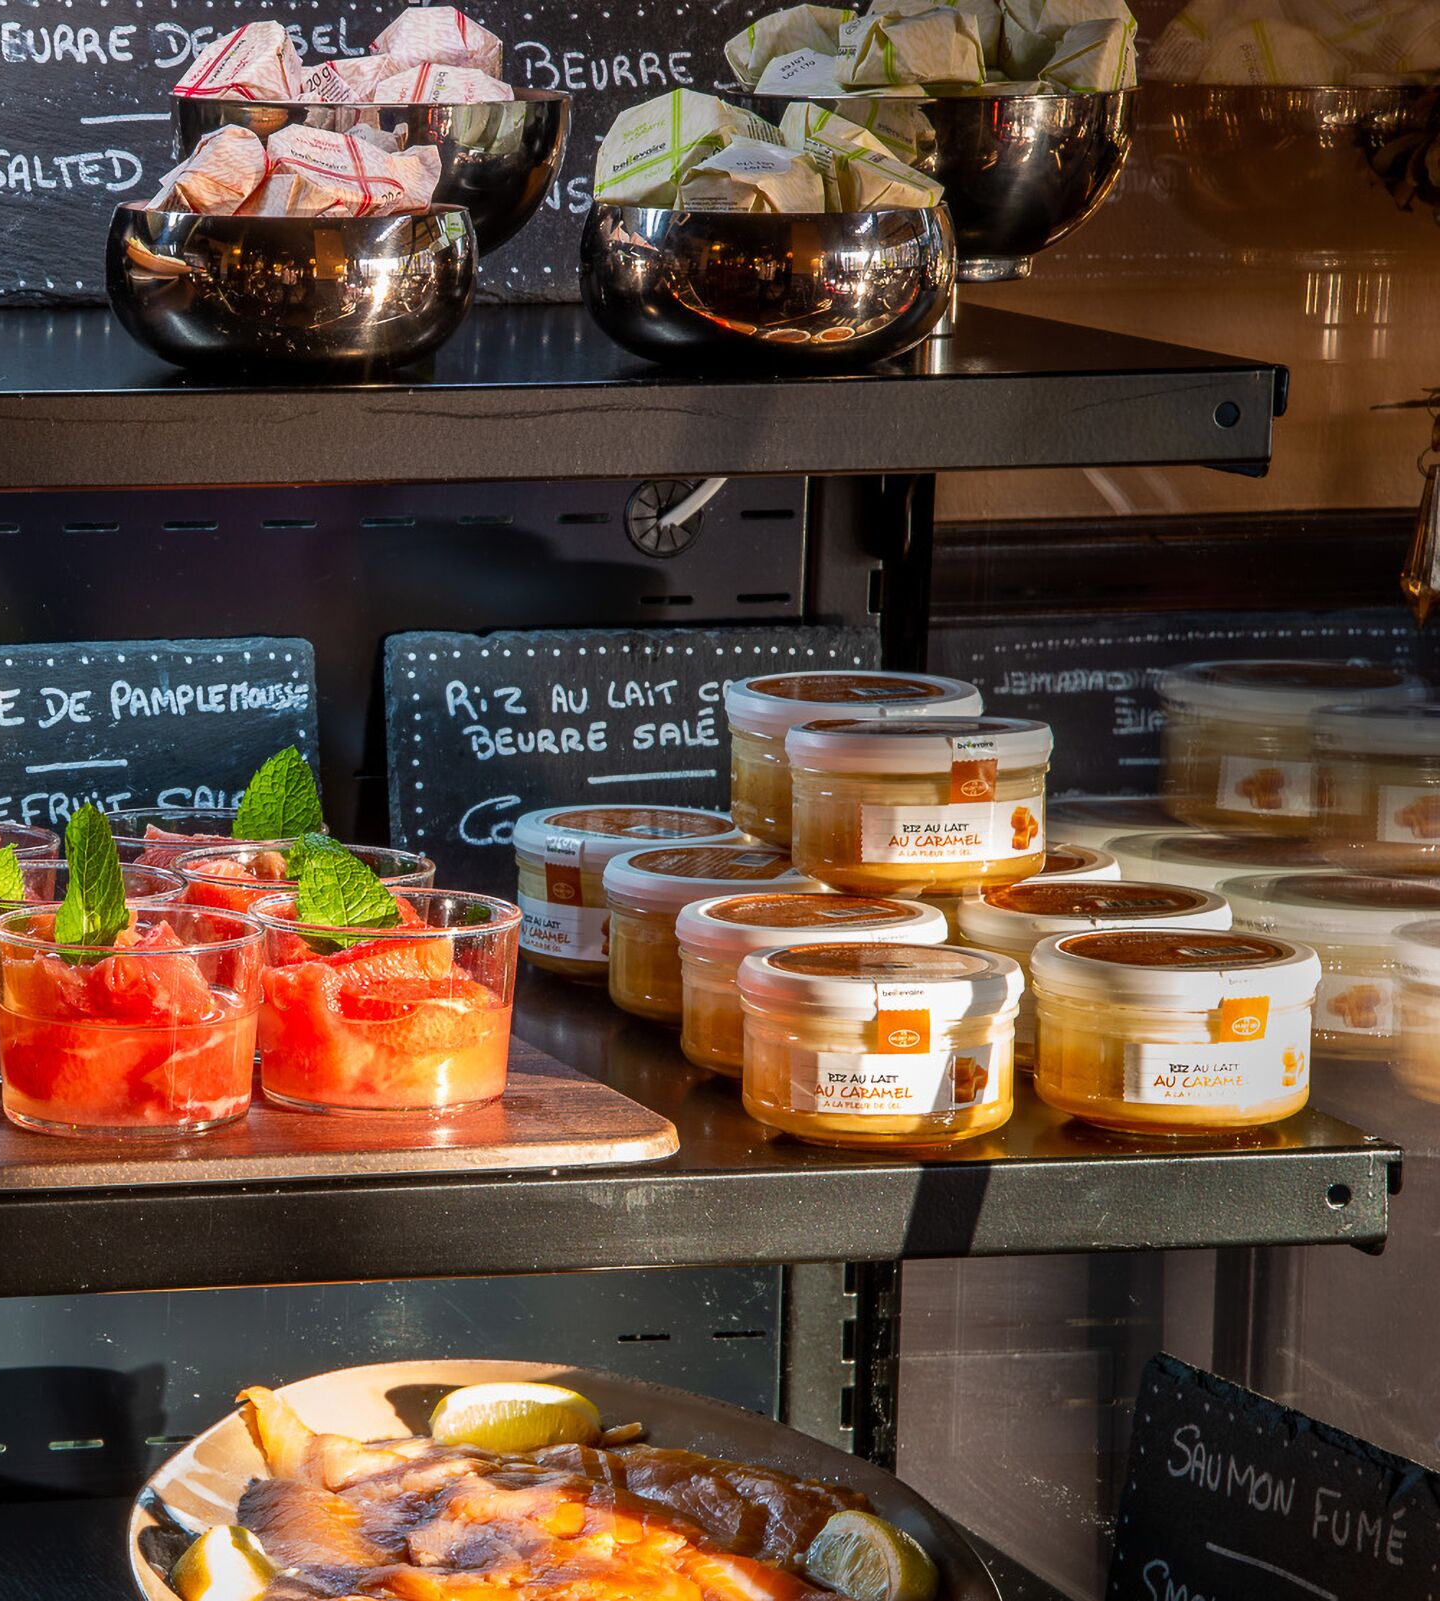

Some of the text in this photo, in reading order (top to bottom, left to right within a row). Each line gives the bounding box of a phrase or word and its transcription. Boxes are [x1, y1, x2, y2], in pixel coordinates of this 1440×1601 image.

[514, 41, 694, 91] BEURRE
[551, 684, 589, 715] AU
[38, 687, 92, 729] DE
[463, 707, 720, 761] BEURRE SALÉ
[902, 823, 971, 834] RIZ AU LAIT
[888, 834, 983, 848] AU CARAMEL
[1169, 1063, 1241, 1074] RIZ AU LAIT
[827, 1072, 899, 1083] RIZ AU LAIT
[1153, 1074, 1176, 1088] AU
[814, 1084, 913, 1099] AU CARAMEL
[1167, 1423, 1407, 1567] SAUMON FUMÉ
